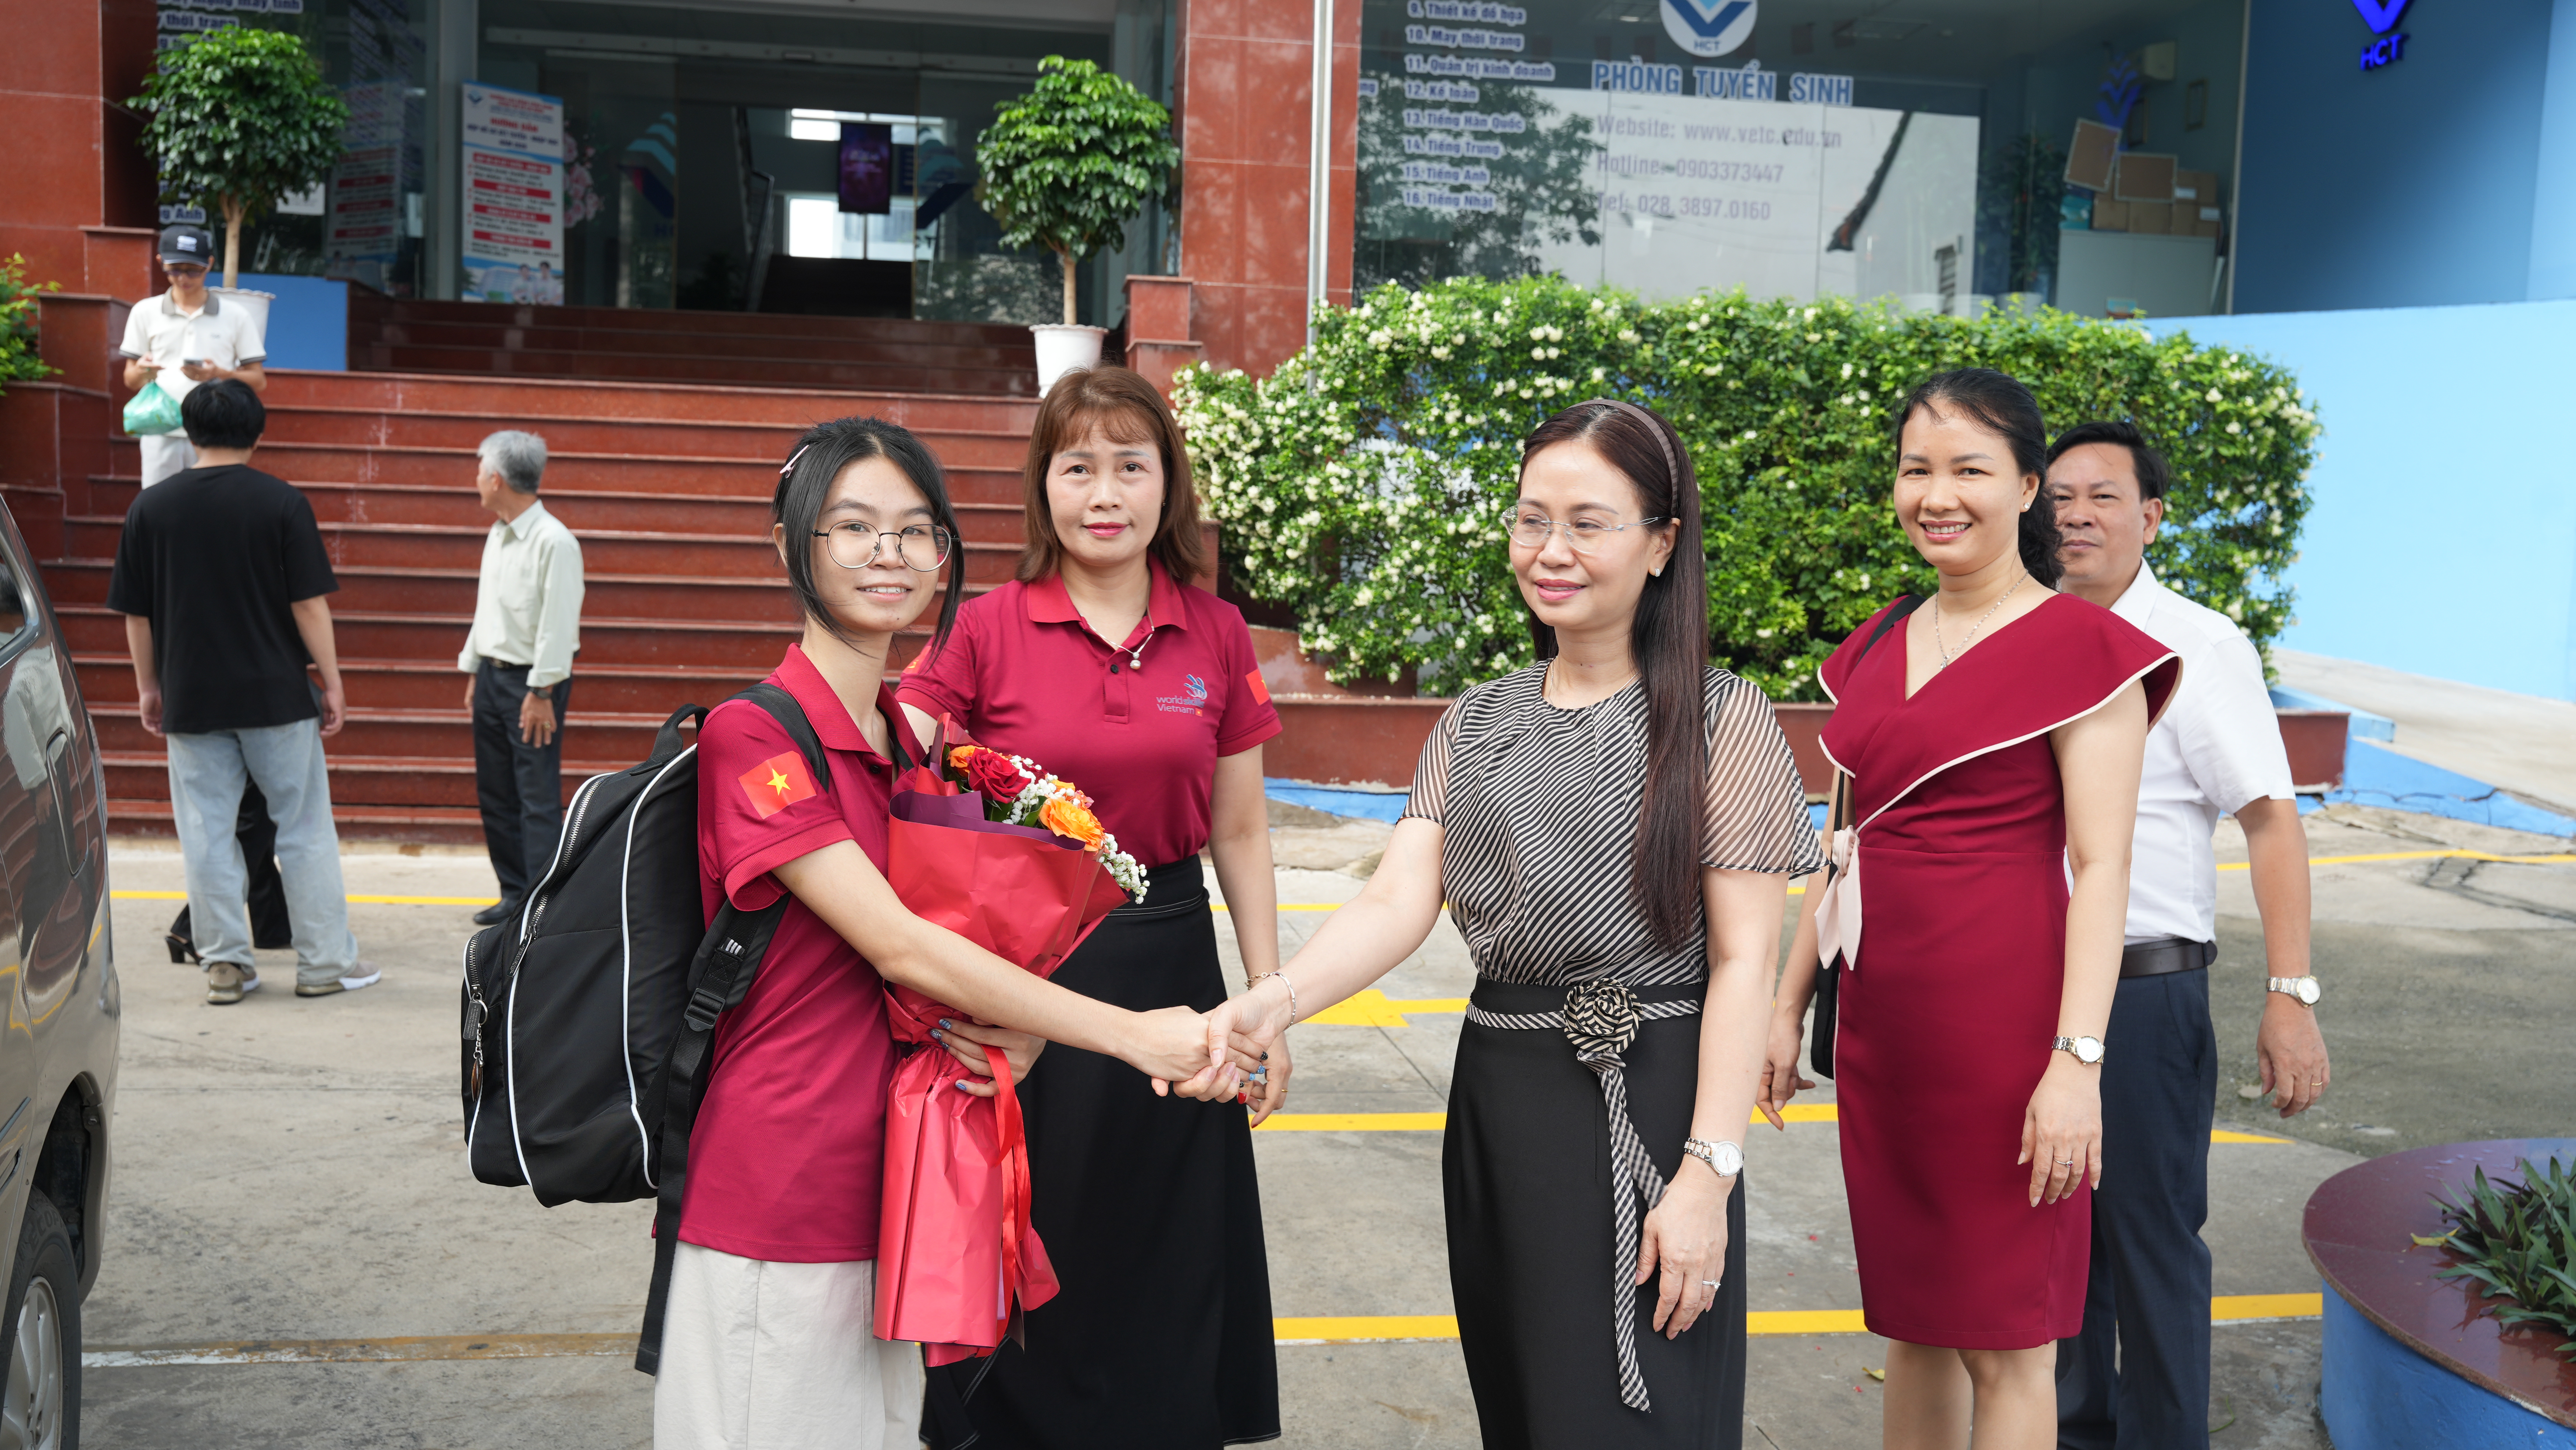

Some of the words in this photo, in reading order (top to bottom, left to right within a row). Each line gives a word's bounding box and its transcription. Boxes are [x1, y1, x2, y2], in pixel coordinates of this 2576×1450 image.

[1410, 2, 1423, 15] 9.
[1428, 3, 1458, 17] Thiết
[1409, 29, 1427, 39] 10.
[1432, 31, 1456, 44] May
[1489, 35, 1521, 48] trang
[1694, 40, 1720, 52] HCT
[2360, 34, 2402, 70] HCT
[1408, 57, 1426, 70] 11.
[1483, 63, 1510, 74] kinh
[1514, 65, 1552, 76] doanh
[1594, 57, 1680, 94] PHÒNG
[1695, 60, 1775, 101] TUYỂN
[1790, 75, 1852, 104] SINH
[1407, 84, 1424, 96] 12.
[1406, 112, 1423, 124] 13.
[1427, 111, 1459, 127] Tiếng
[1492, 115, 1522, 129] Quốc
[1598, 115, 1675, 138] Website:
[1407, 139, 1424, 151] 14.
[1428, 138, 1460, 153] Tiếng
[1466, 142, 1499, 156] Trung
[1406, 166, 1423, 178] 15.
[1427, 165, 1459, 181] Tiếng
[1464, 170, 1487, 181] Anh
[1598, 153, 1666, 175] Hotline:
[1675, 158, 1784, 182] 0903373447
[1406, 192, 1423, 203] 16.
[1428, 191, 1459, 207] Tiếng
[1465, 196, 1493, 210] Nhật
[1597, 191, 1629, 211] Tel:
[1156, 695, 1205, 708] worldskills
[1157, 704, 1195, 714] Vietnam
